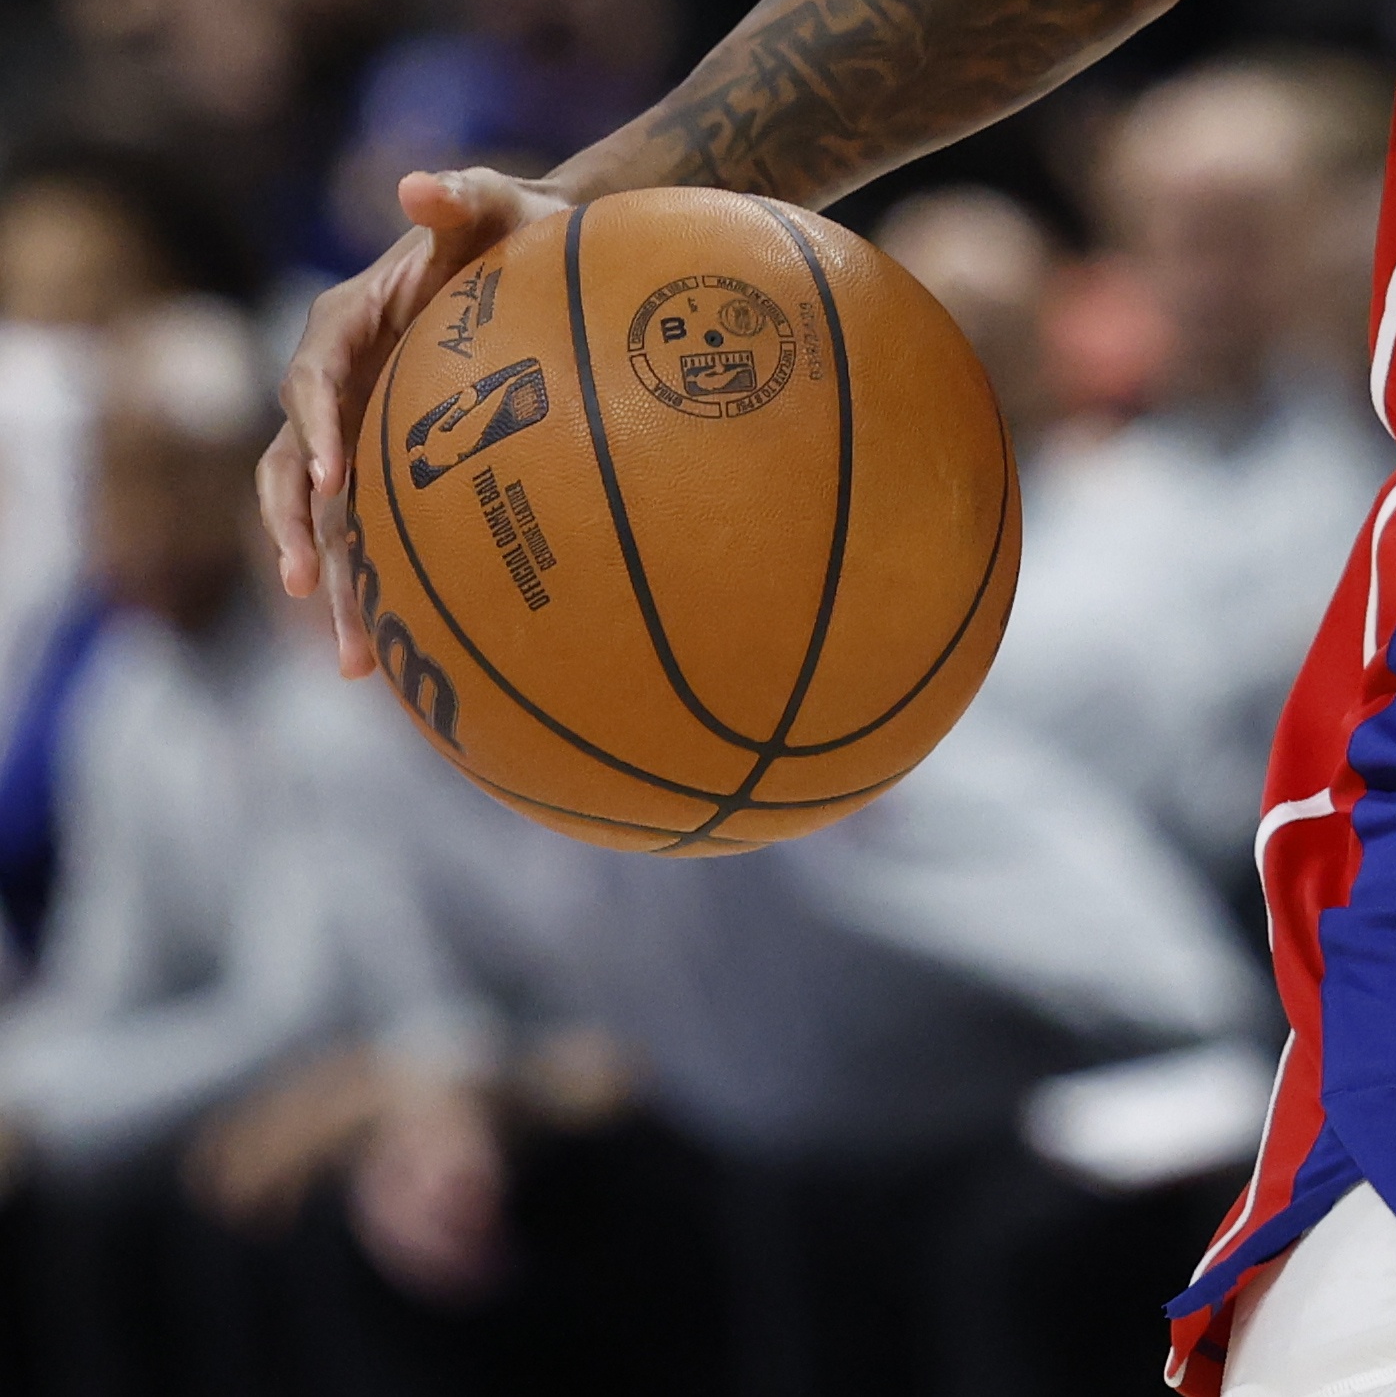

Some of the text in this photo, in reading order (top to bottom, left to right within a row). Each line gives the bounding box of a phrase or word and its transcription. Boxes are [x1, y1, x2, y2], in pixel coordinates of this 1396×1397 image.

[472, 465, 551, 612] OFFICIAL GAME BALL
[504, 478, 558, 572] GENUINE LEATHER
